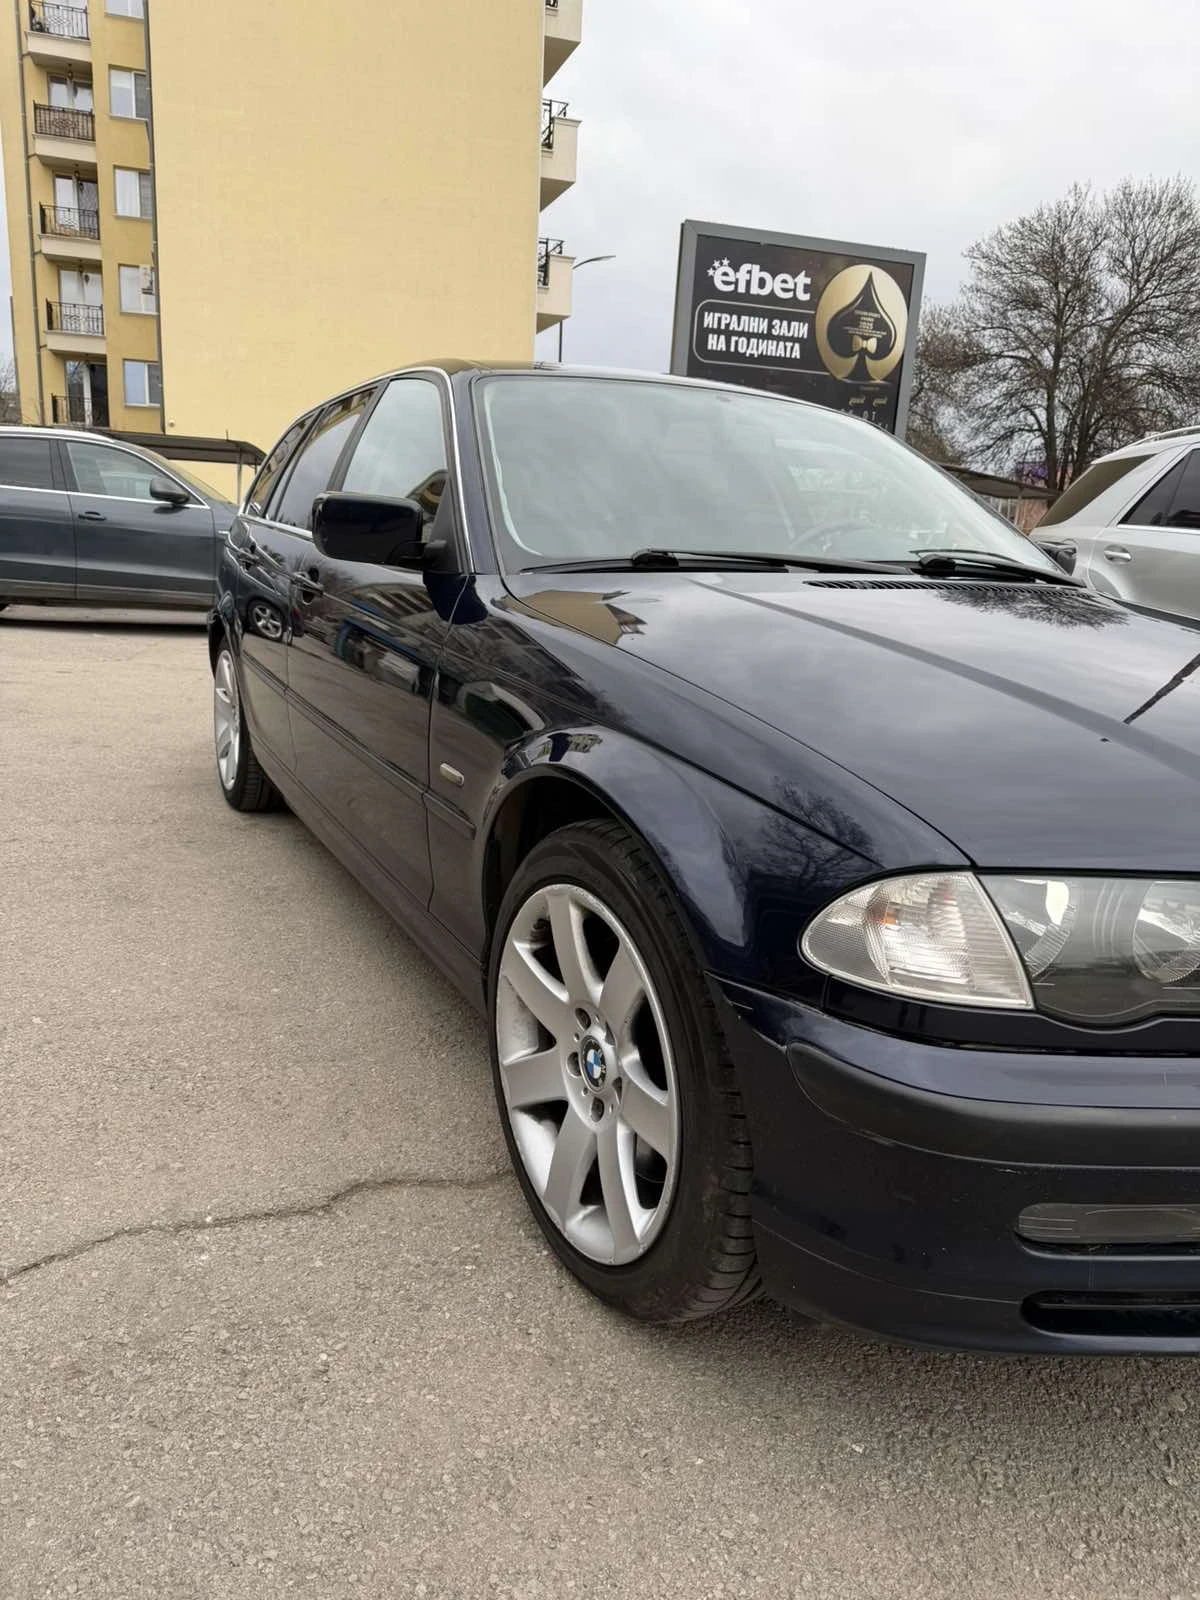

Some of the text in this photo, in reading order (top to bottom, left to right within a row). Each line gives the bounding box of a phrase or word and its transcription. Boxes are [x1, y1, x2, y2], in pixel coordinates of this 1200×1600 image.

[713, 263, 811, 301] efbet
[703, 311, 809, 339] ИГРАЛНИ ЗАЛИ
[707, 333, 801, 360] НА ГОДИНАТА
